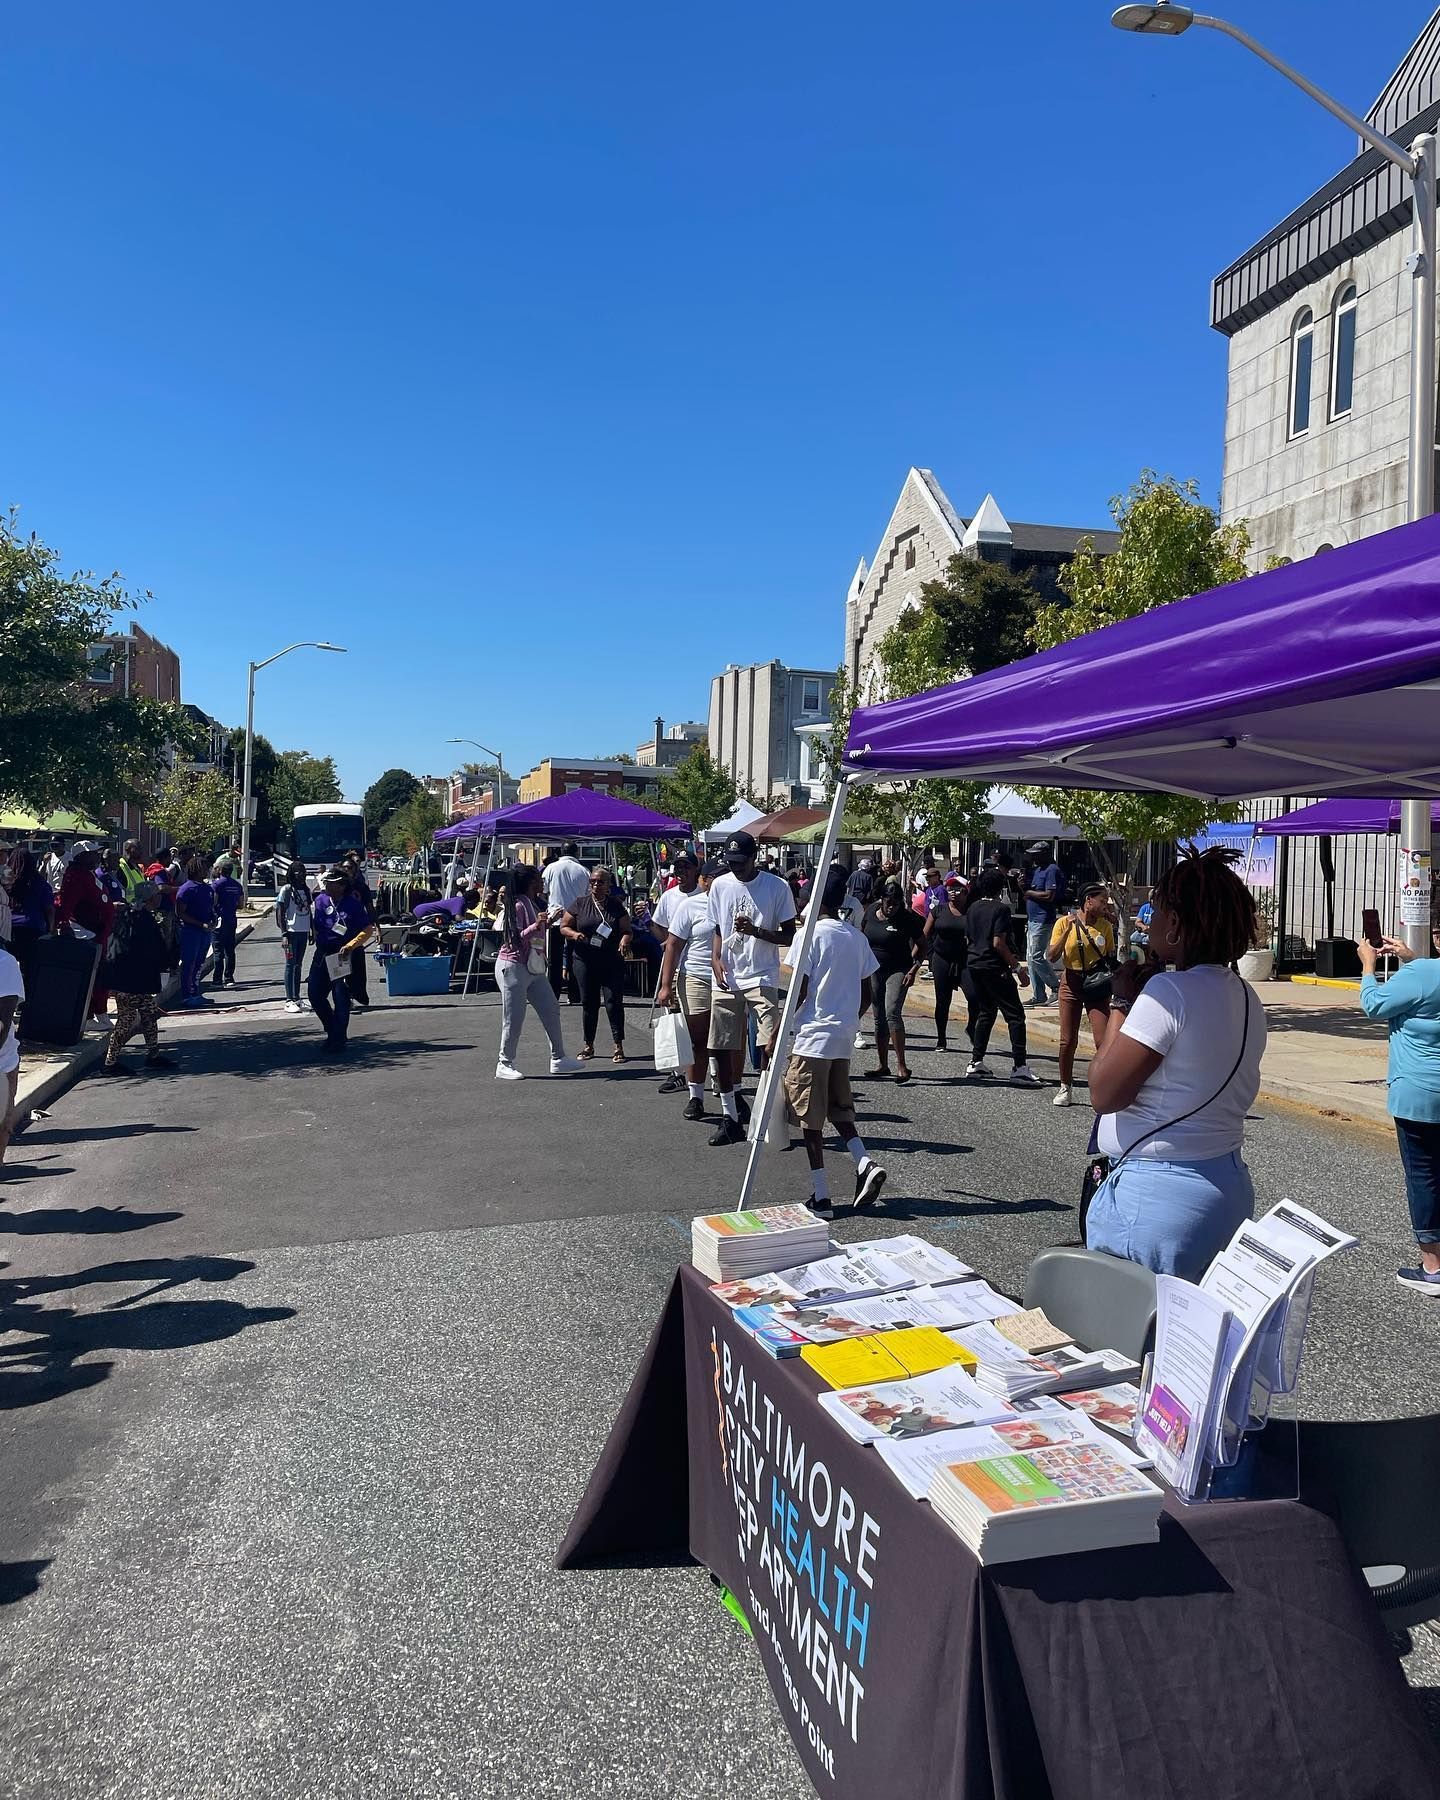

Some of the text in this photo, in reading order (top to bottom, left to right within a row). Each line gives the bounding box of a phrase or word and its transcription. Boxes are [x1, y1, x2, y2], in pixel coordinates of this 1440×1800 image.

[1206, 837, 1263, 850] COMMUNIY
[1402, 889, 1412, 897] NO
[722, 1340, 882, 1590] BALTIMORE
[725, 1404, 765, 1503] CITY
[730, 1457, 865, 1744] EPARTMENT
[771, 1475, 870, 1669] HEALTH
[800, 1696, 836, 1781] Point
